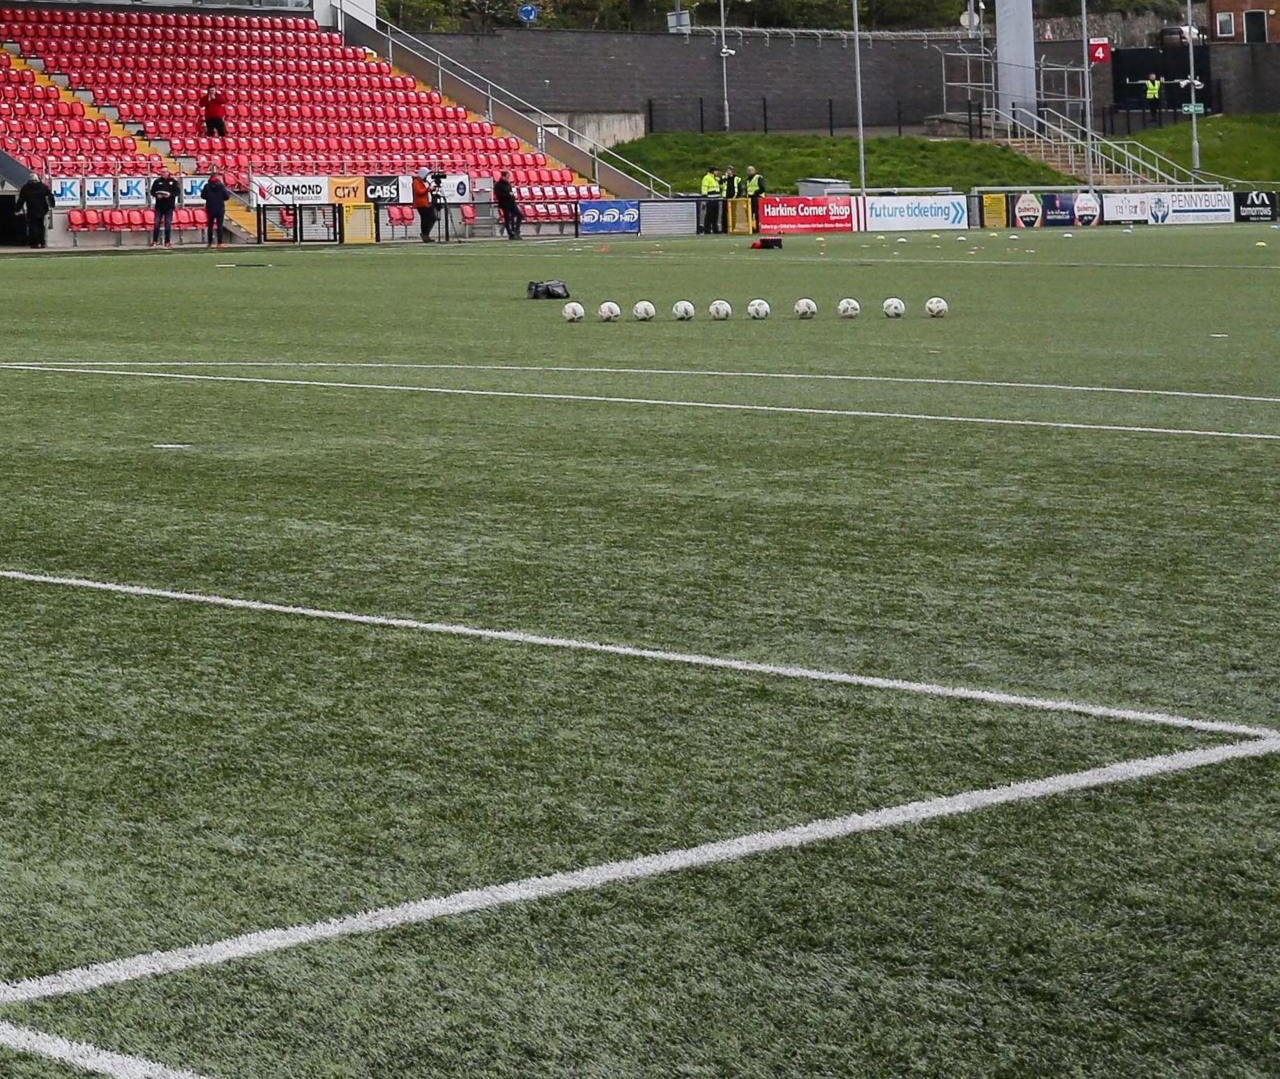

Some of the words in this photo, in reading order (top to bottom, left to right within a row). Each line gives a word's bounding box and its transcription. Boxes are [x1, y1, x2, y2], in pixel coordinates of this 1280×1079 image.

[1093, 46, 1104, 59] 4
[274, 184, 323, 195] DIAMOND
[334, 186, 359, 199] CITY
[366, 185, 397, 198] CABS
[1171, 193, 1232, 208] PENNYBURN
[764, 204, 796, 217] Harkins
[798, 204, 827, 216] Corner
[828, 203, 851, 217] Shop
[869, 204, 905, 219] future
[906, 202, 951, 220] ticketing
